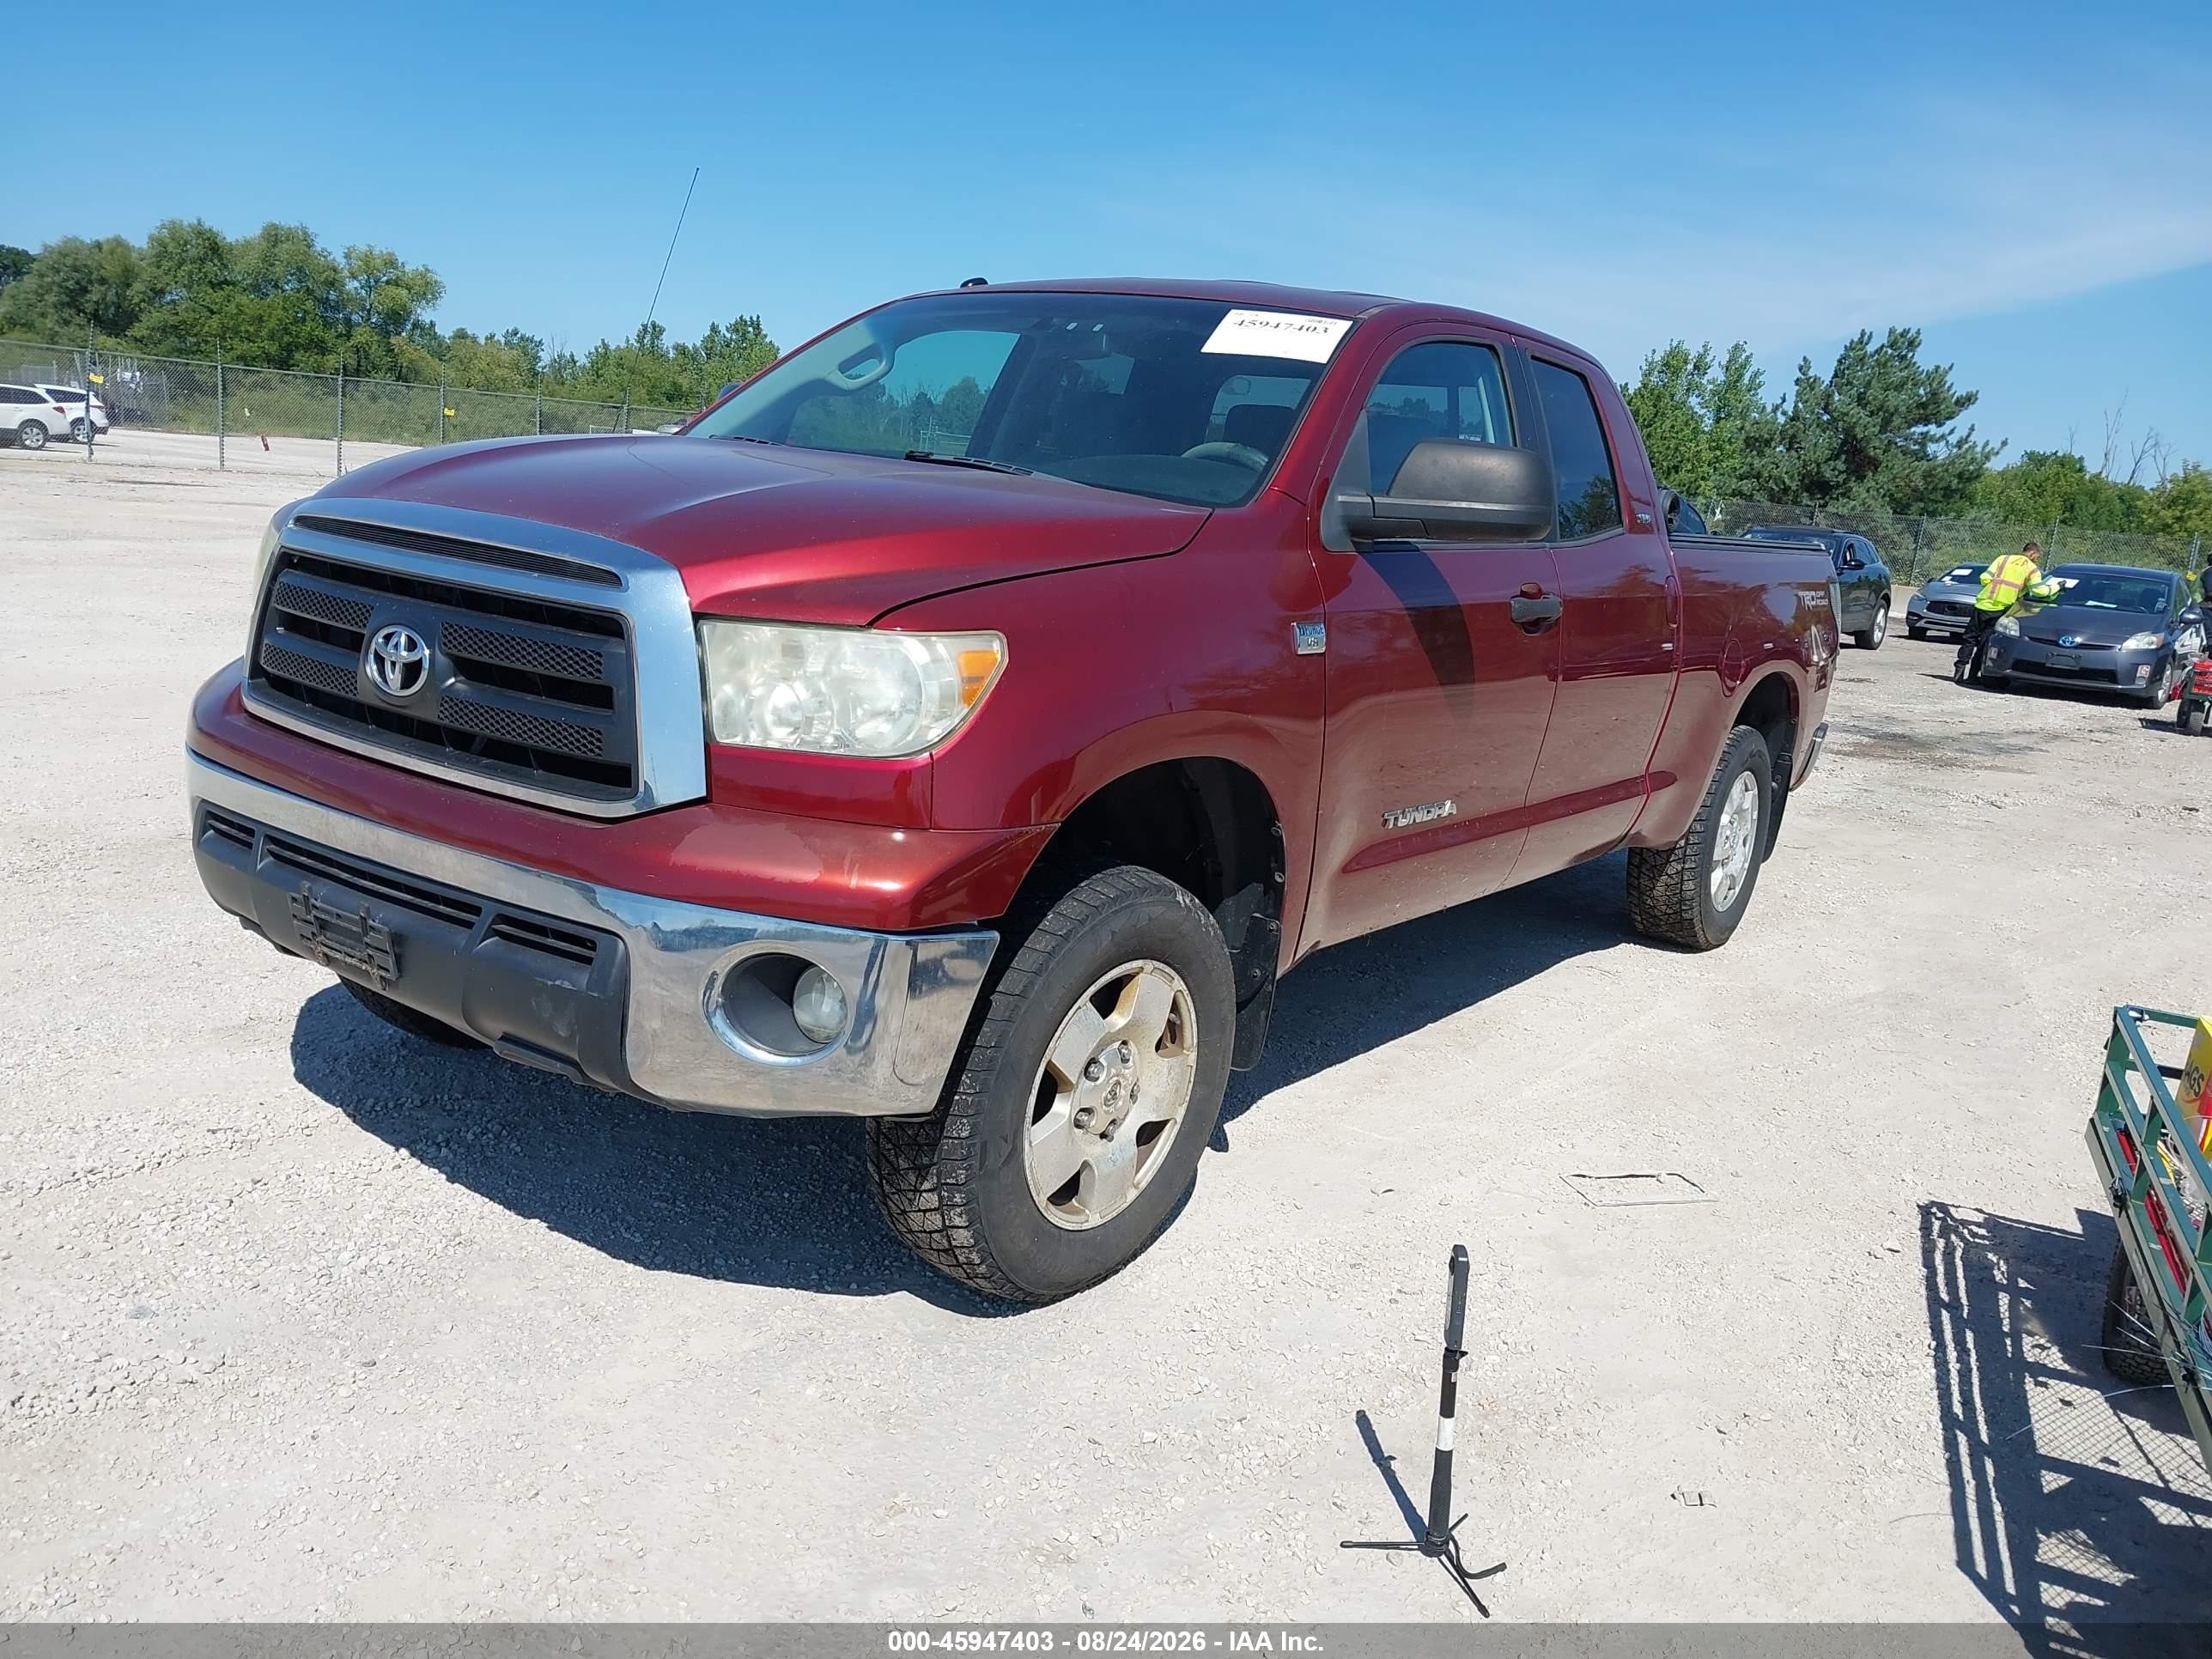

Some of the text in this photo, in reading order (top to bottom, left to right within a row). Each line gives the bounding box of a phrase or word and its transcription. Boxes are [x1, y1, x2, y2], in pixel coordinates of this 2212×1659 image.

[1233, 319, 1329, 334] 45947403
[1798, 591, 1816, 611] TRD
[1382, 799, 1457, 830] TUNDRA
